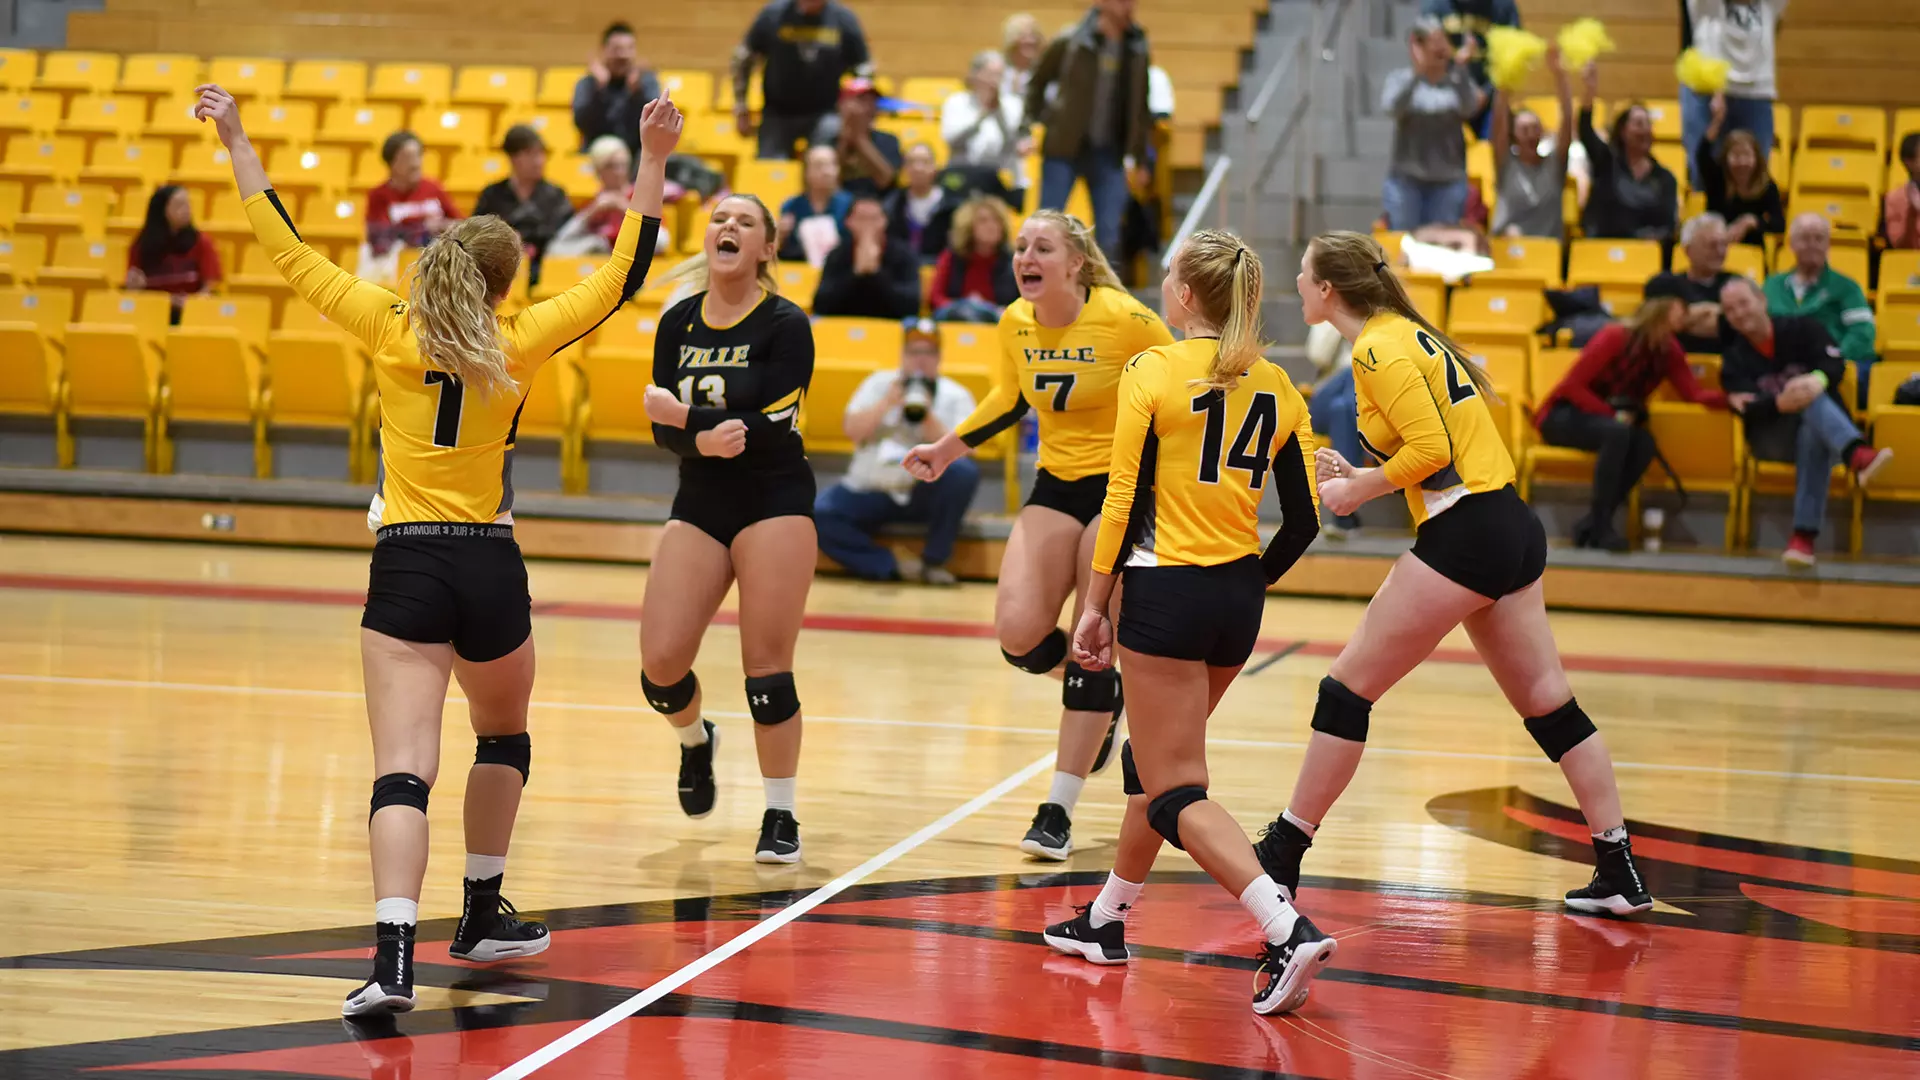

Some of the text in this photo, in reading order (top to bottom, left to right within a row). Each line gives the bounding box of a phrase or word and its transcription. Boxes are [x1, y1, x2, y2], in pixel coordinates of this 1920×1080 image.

[678, 344, 750, 369] VILLE
[1023, 346, 1096, 364] VILLE
[677, 374, 728, 408] 13
[1034, 372, 1077, 411] 7
[1191, 388, 1279, 490] 14
[403, 525, 441, 535] ARMOUR
